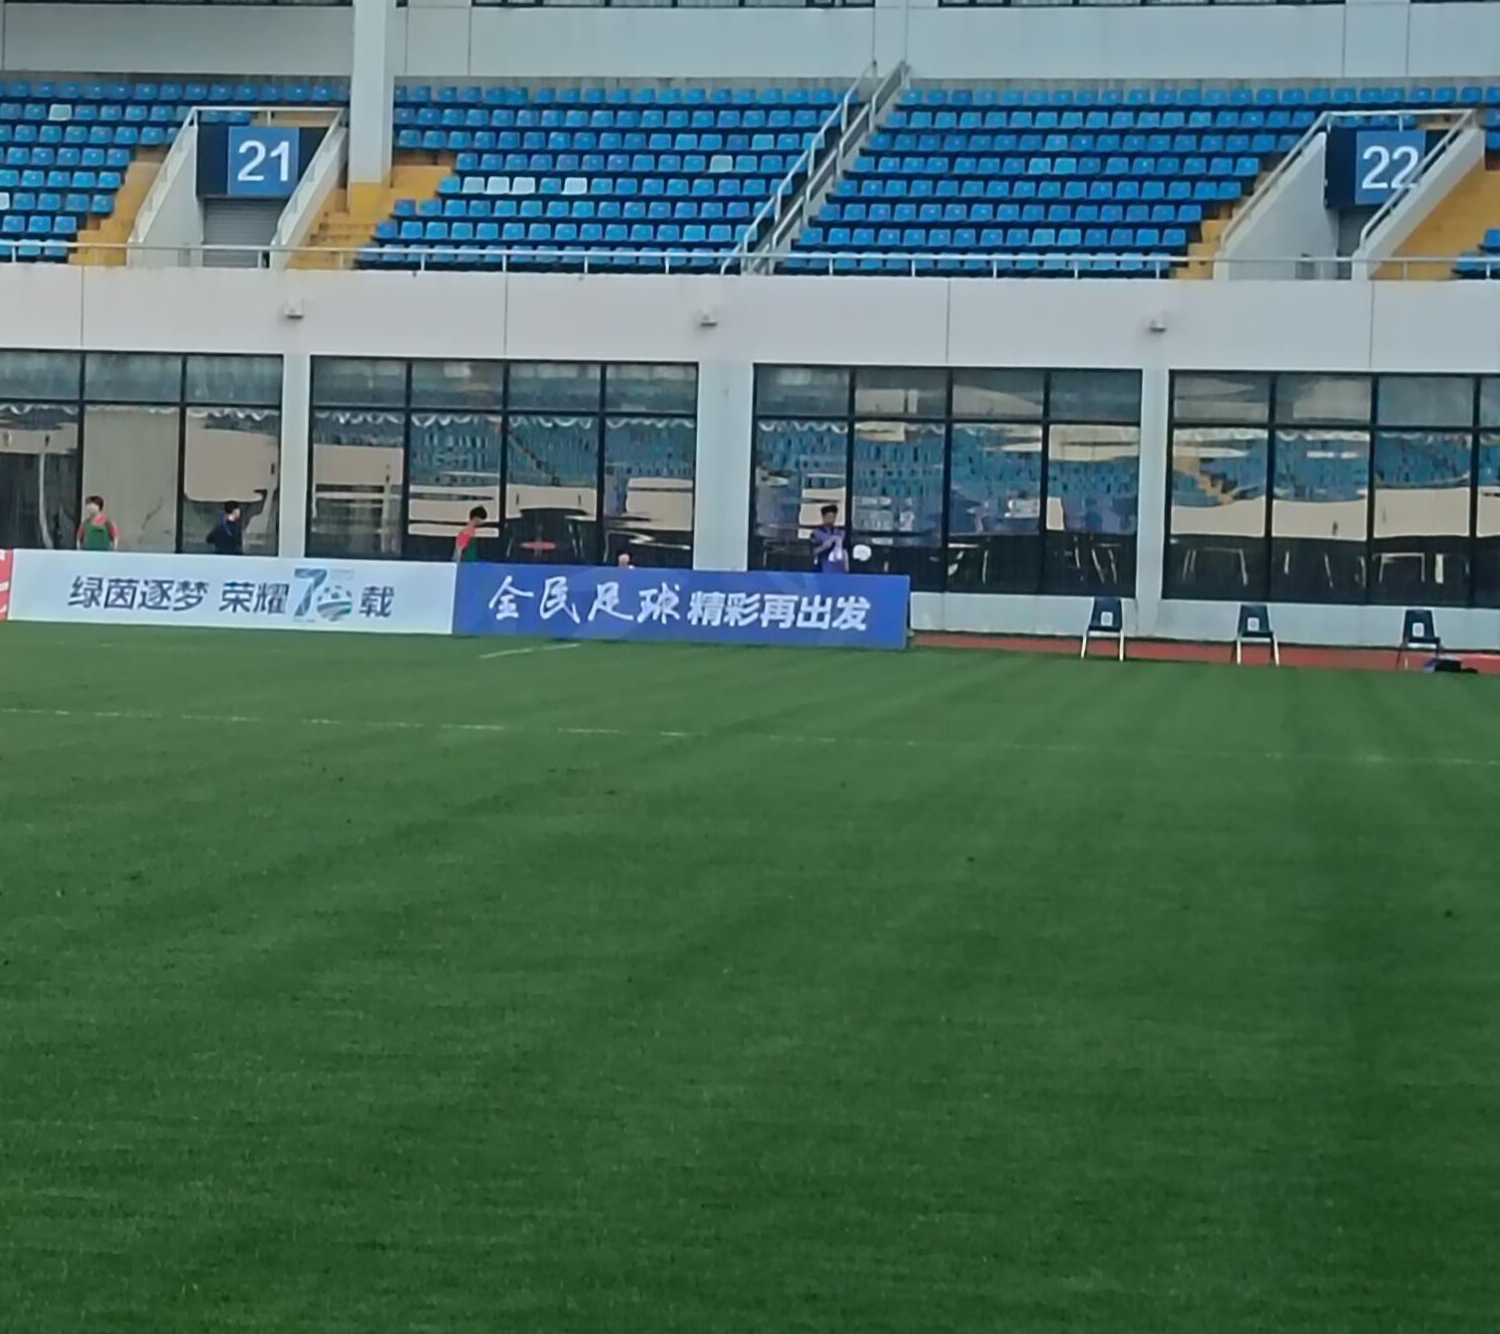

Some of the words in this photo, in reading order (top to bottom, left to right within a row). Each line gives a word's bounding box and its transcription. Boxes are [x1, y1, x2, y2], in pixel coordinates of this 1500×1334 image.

[237, 139, 290, 182] 21
[1362, 145, 1419, 190] 22
[68, 575, 209, 612] 绿茵逐梦
